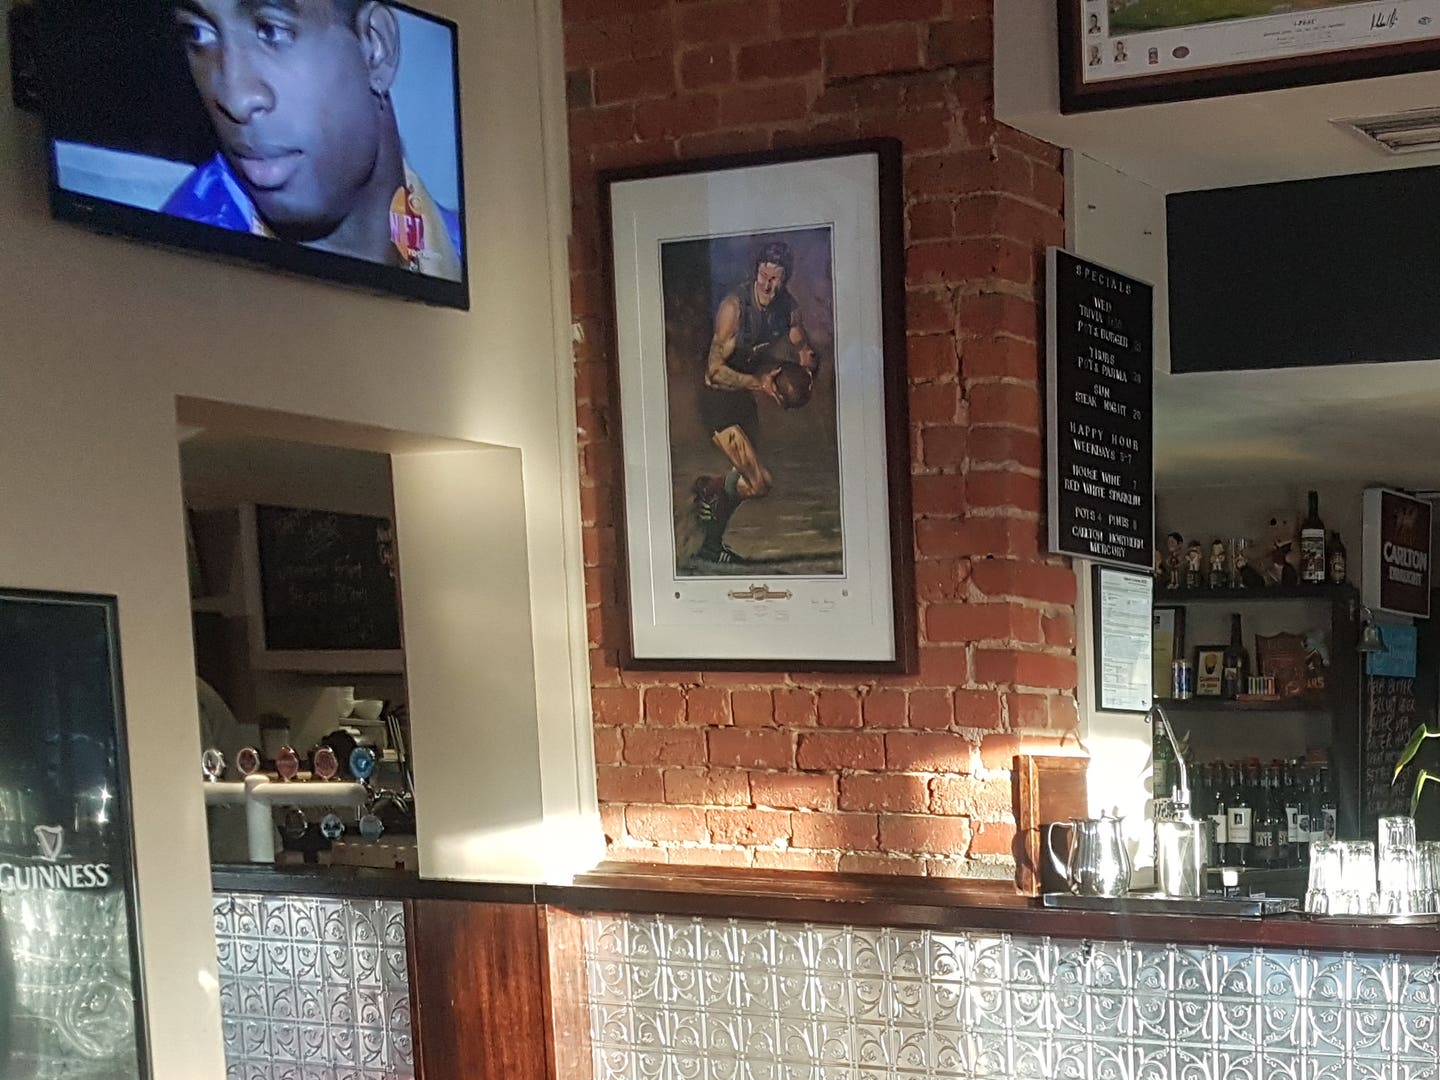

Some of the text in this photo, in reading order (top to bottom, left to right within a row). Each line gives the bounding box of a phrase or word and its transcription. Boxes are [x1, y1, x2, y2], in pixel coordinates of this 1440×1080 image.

[1075, 264, 1132, 295] SPECIALS
[1089, 346, 1115, 366] THURS
[1101, 364, 1128, 383] PARMA
[1093, 384, 1110, 398] SUN
[1075, 391, 1097, 408] STEAK
[1103, 399, 1127, 417] NIGHT
[1069, 421, 1139, 451] HAPPY HOUR
[1073, 438, 1116, 461] WEEKDAYS
[1072, 464, 1098, 481] HOUSE
[1101, 471, 1121, 487] WINE
[1064, 478, 1080, 492] RED
[1082, 482, 1106, 499] WHITE
[1075, 506, 1096, 521] POTS
[1108, 514, 1130, 528] PINTS
[1071, 525, 1103, 542] CARLTON
[1089, 541, 1126, 558] MERCURY
[1383, 541, 1428, 571] CARLTON
[0, 863, 110, 891] GUINNESS
